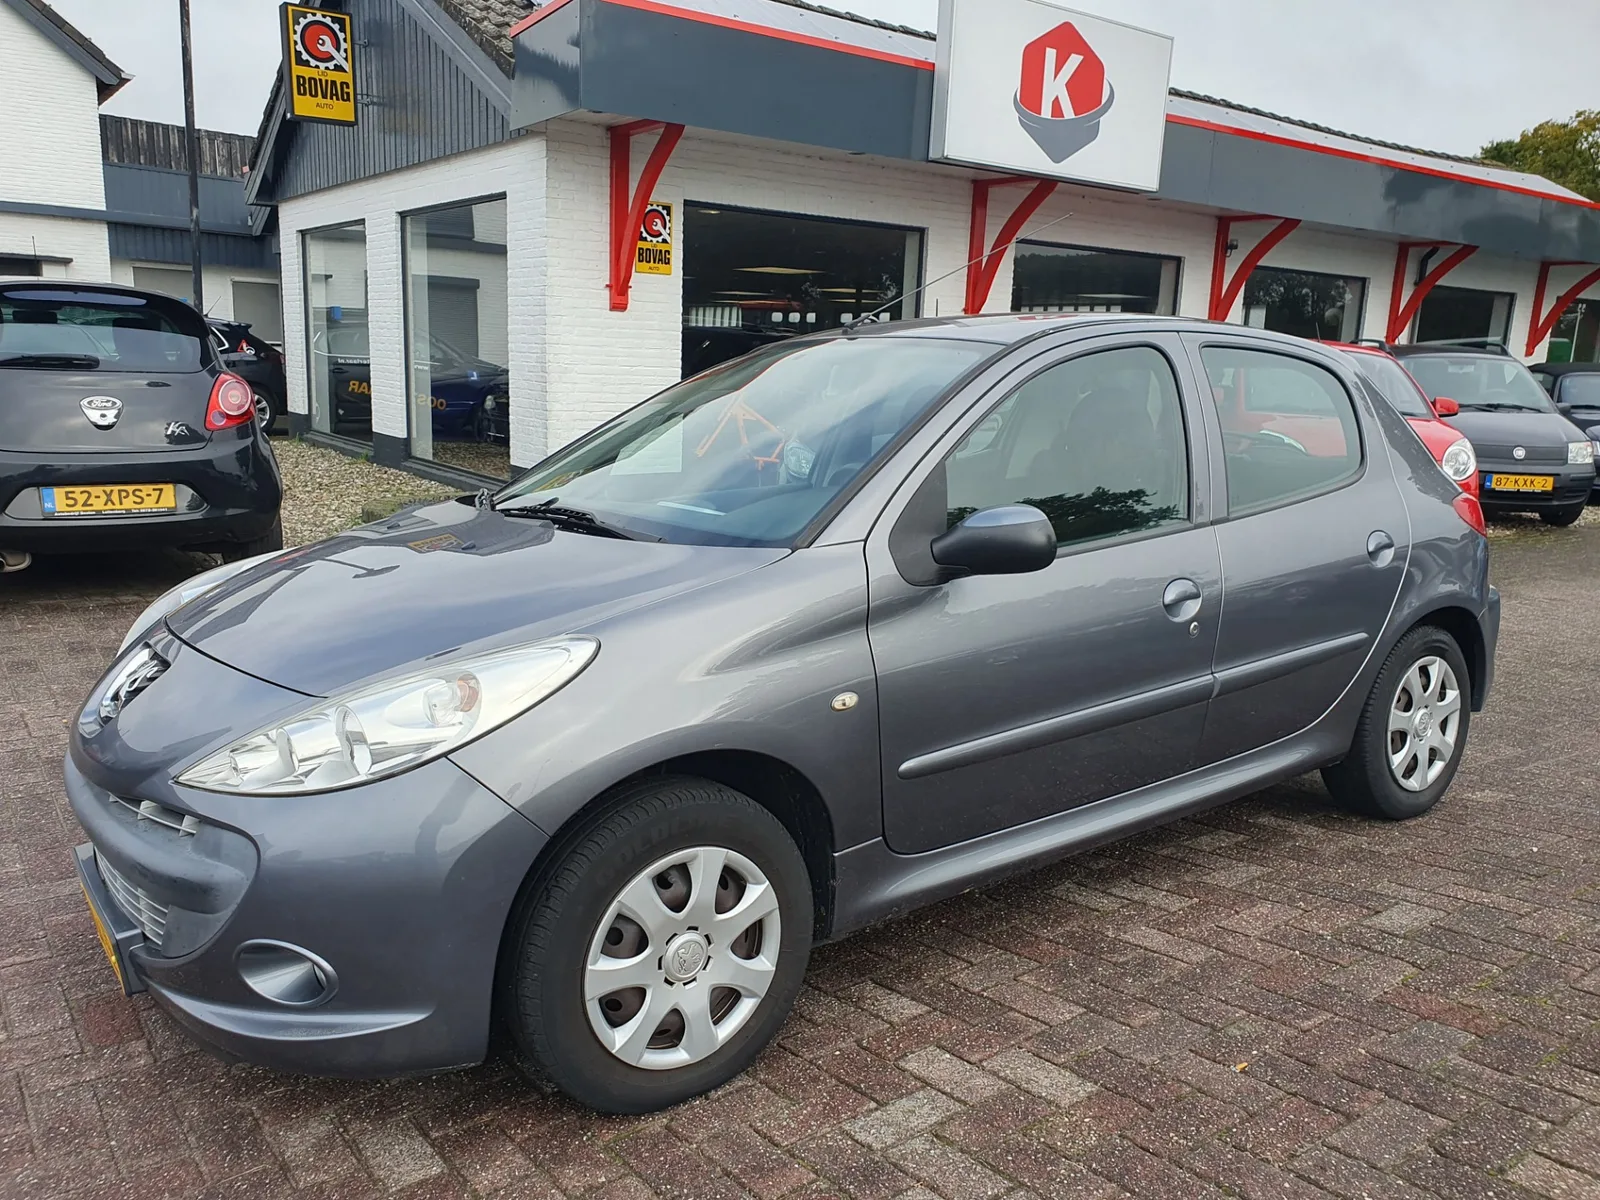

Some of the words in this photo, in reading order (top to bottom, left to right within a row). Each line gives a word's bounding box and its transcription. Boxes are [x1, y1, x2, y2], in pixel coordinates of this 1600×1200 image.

[296, 74, 351, 103] BOVAG
[1040, 46, 1084, 119] K
[315, 102, 333, 110] AUTO
[638, 247, 670, 265] BOVAG
[91, 398, 113, 407] Ford
[1495, 476, 1548, 488] 87-KXK-2
[64, 488, 164, 508] 52-XPS-7
